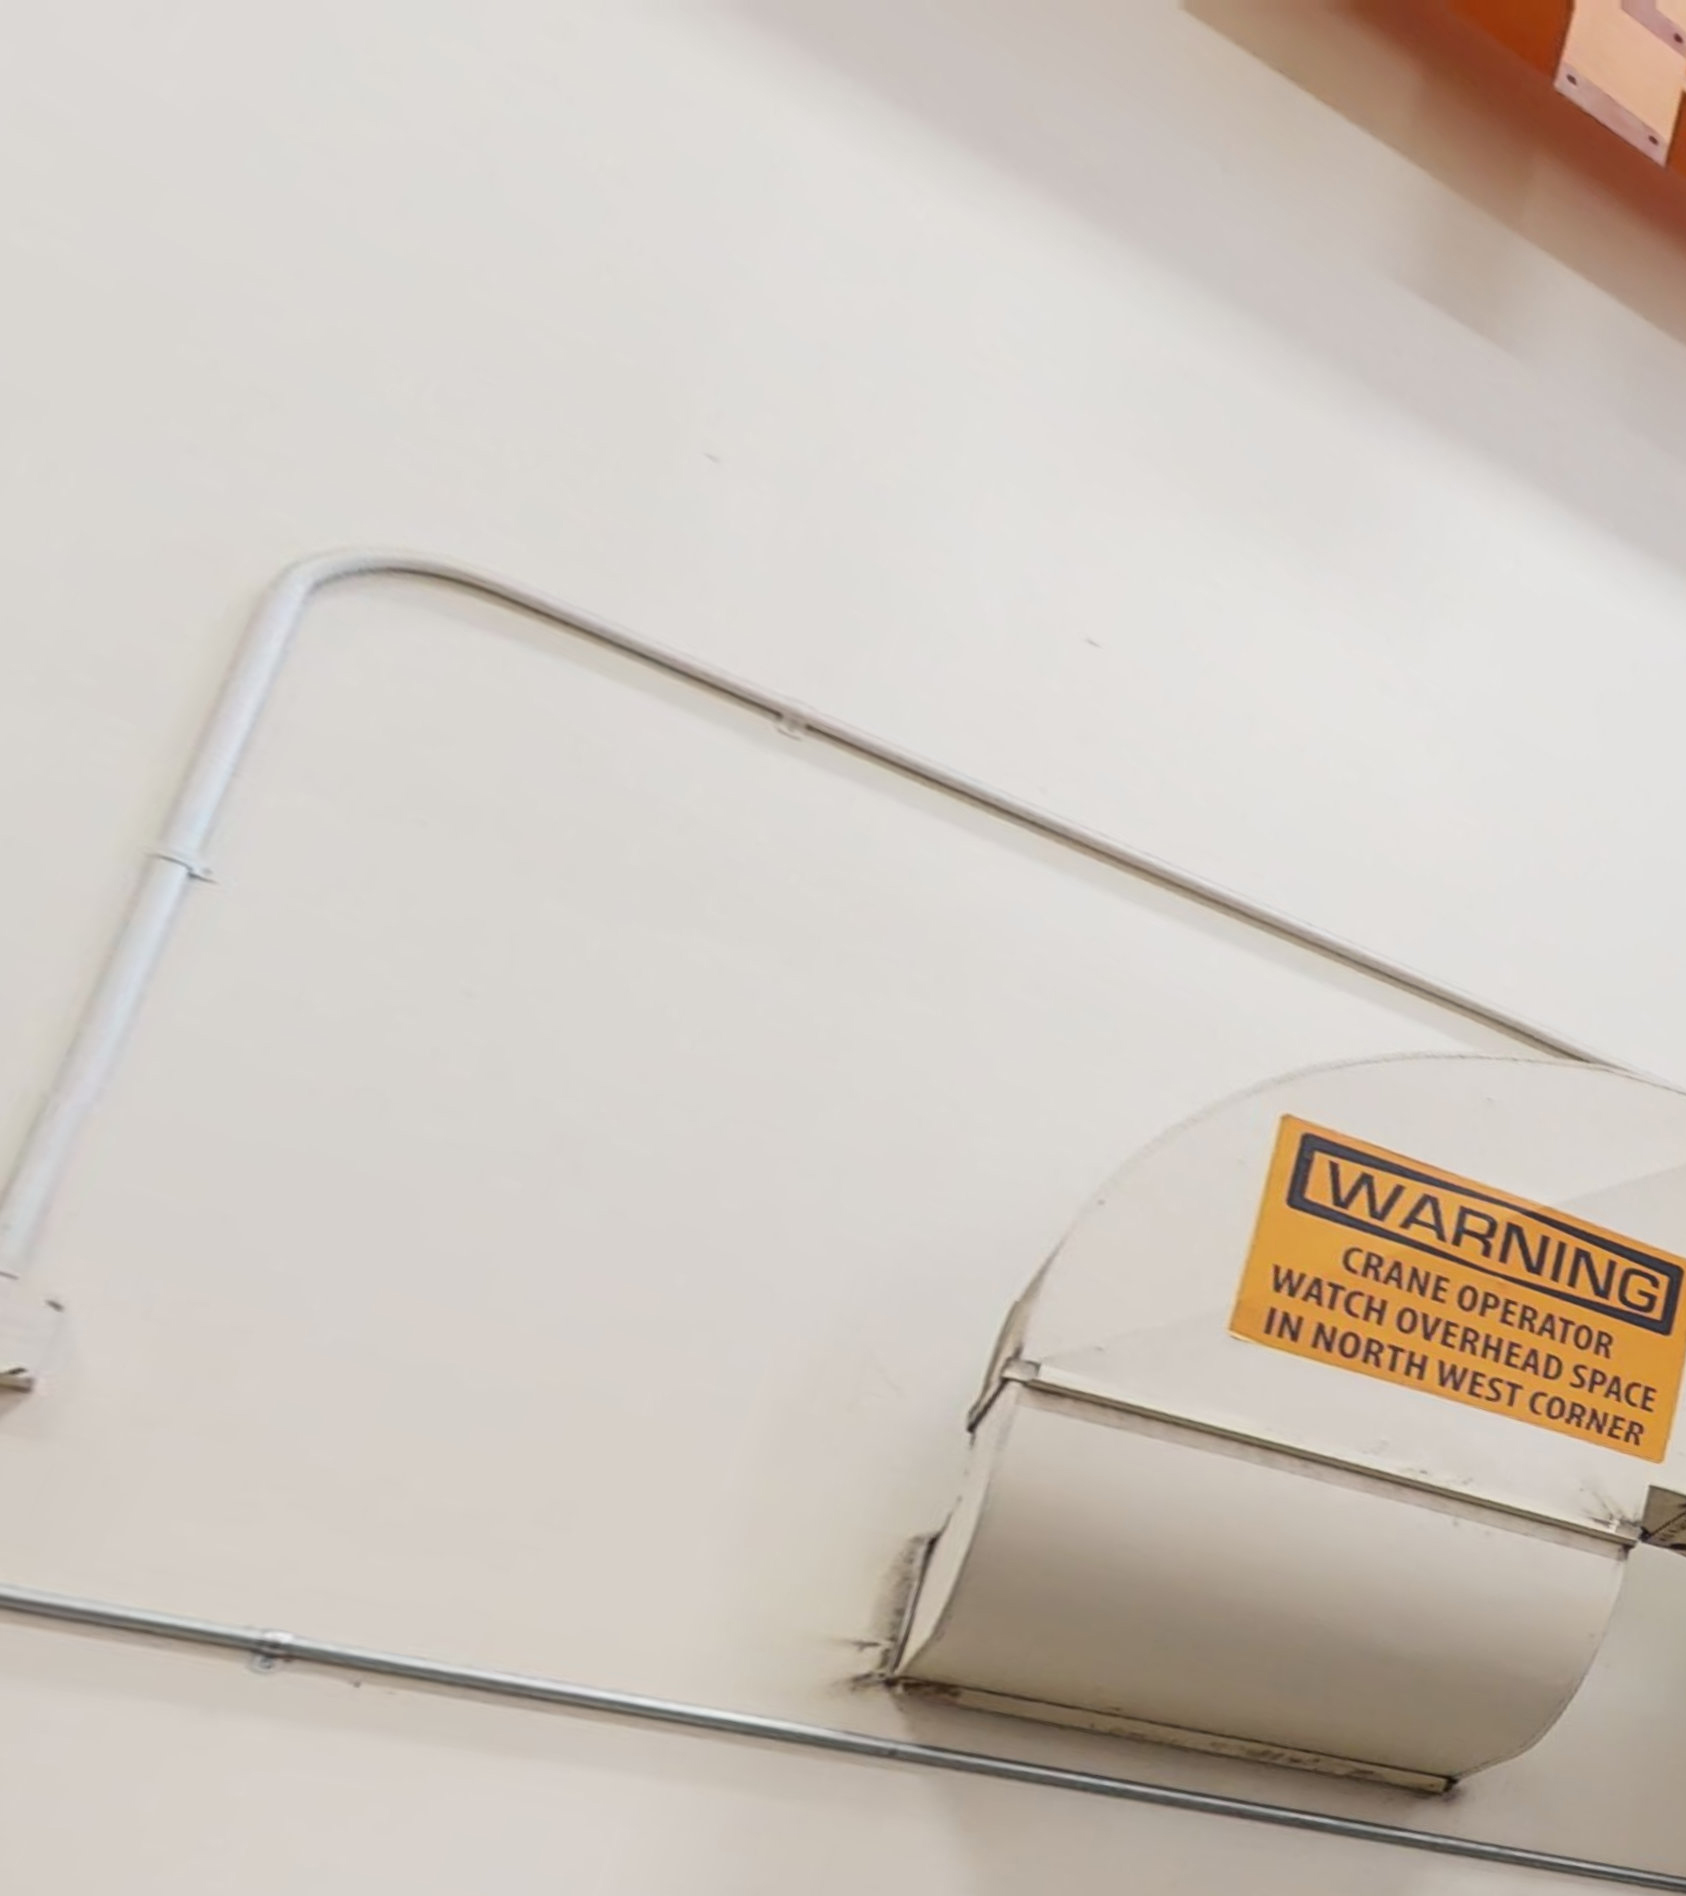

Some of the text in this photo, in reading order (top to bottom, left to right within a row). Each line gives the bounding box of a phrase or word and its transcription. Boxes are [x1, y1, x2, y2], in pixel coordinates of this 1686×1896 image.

[1328, 1160, 1661, 1313] WARNING
[1342, 1247, 1614, 1359] CRANE OPERATOR
[1264, 1306, 1645, 1446] IN NORTH WEST CORNER
[1271, 1263, 1657, 1412] WATCH OVERHEAD SPACE
